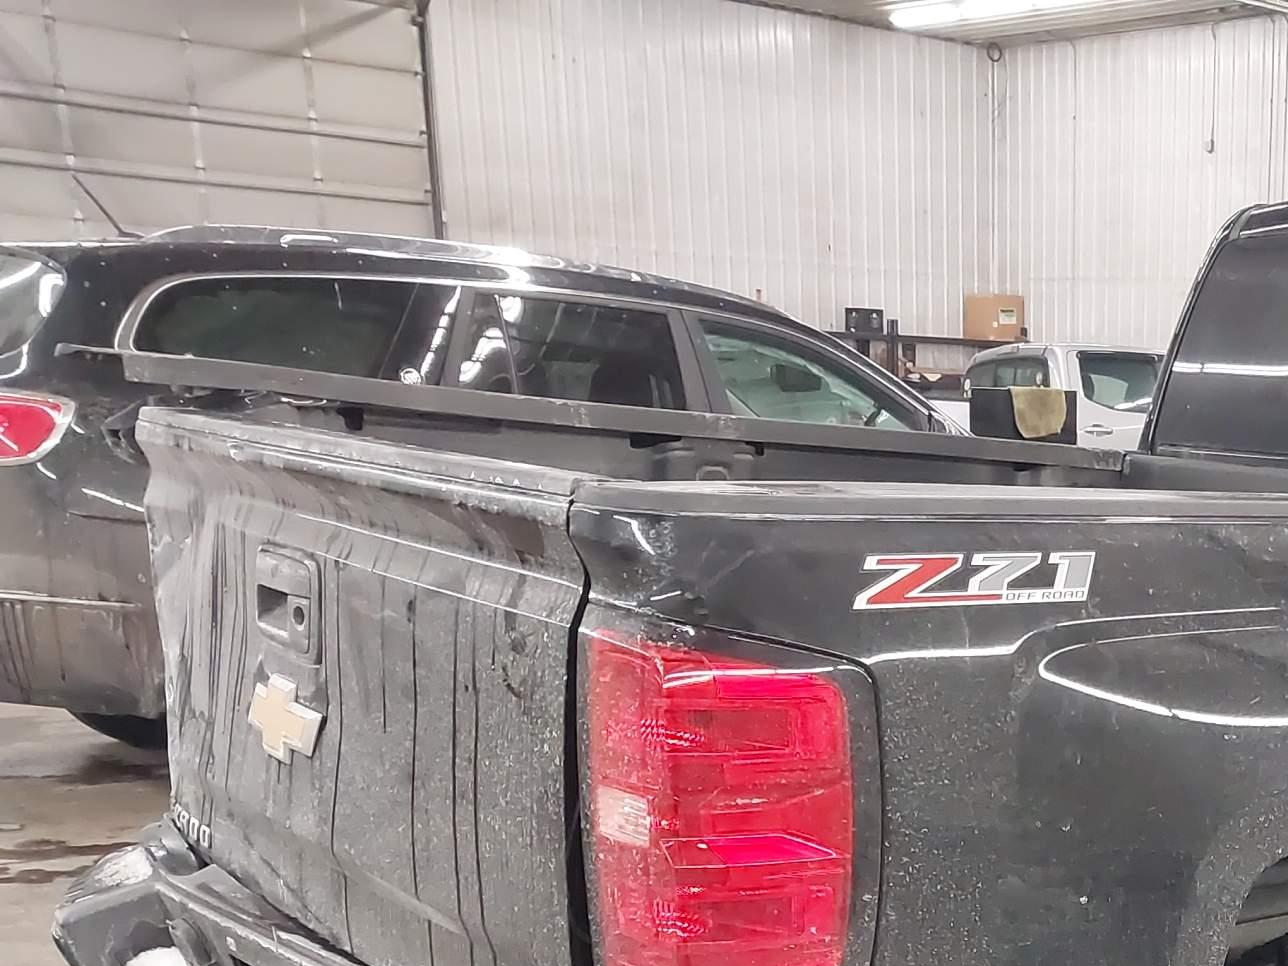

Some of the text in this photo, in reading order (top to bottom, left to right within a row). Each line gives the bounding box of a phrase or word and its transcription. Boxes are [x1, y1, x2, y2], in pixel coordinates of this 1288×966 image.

[852, 552, 1096, 610] Z71
[1005, 590, 1085, 601] OFF ROAD
